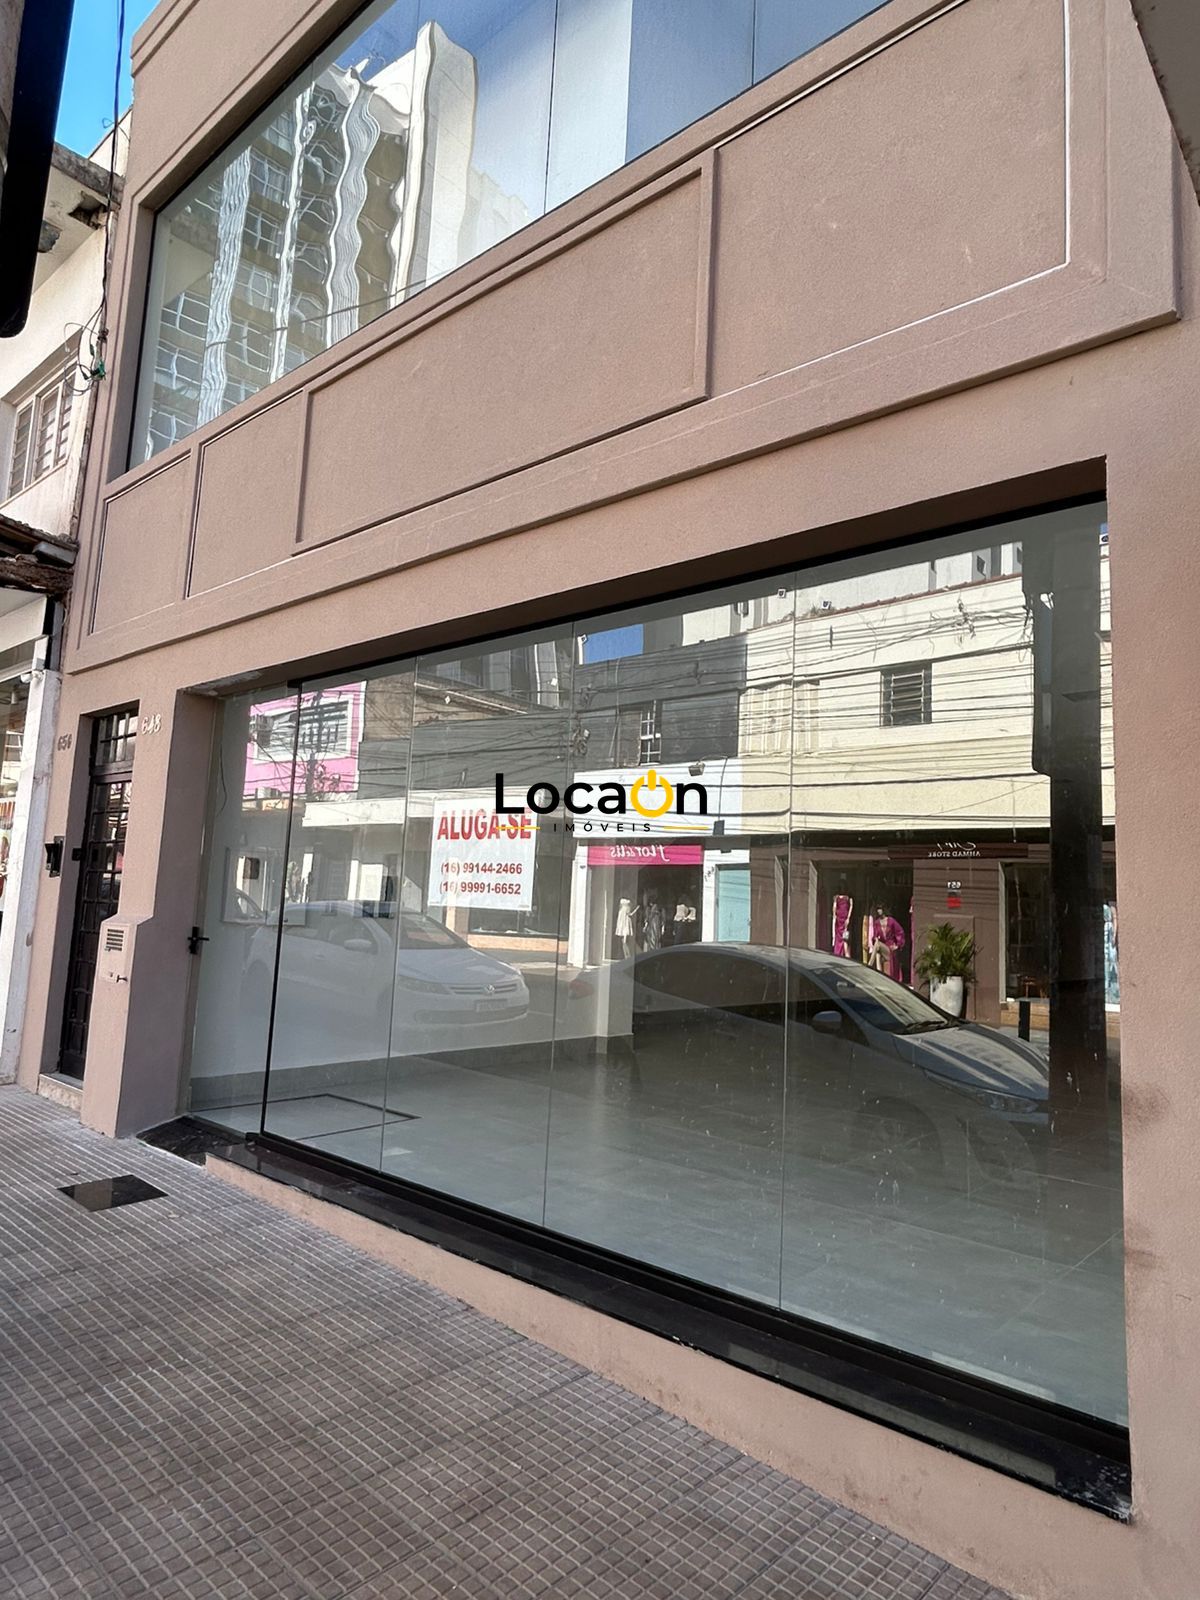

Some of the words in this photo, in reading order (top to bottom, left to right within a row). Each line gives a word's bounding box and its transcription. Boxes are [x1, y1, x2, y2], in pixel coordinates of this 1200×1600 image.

[141, 713, 161, 734] 648
[437, 809, 533, 841] ALUGA-SE
[440, 862, 460, 876] (16)
[462, 862, 523, 875] 99144-2466
[460, 881, 521, 895] 99991-6652
